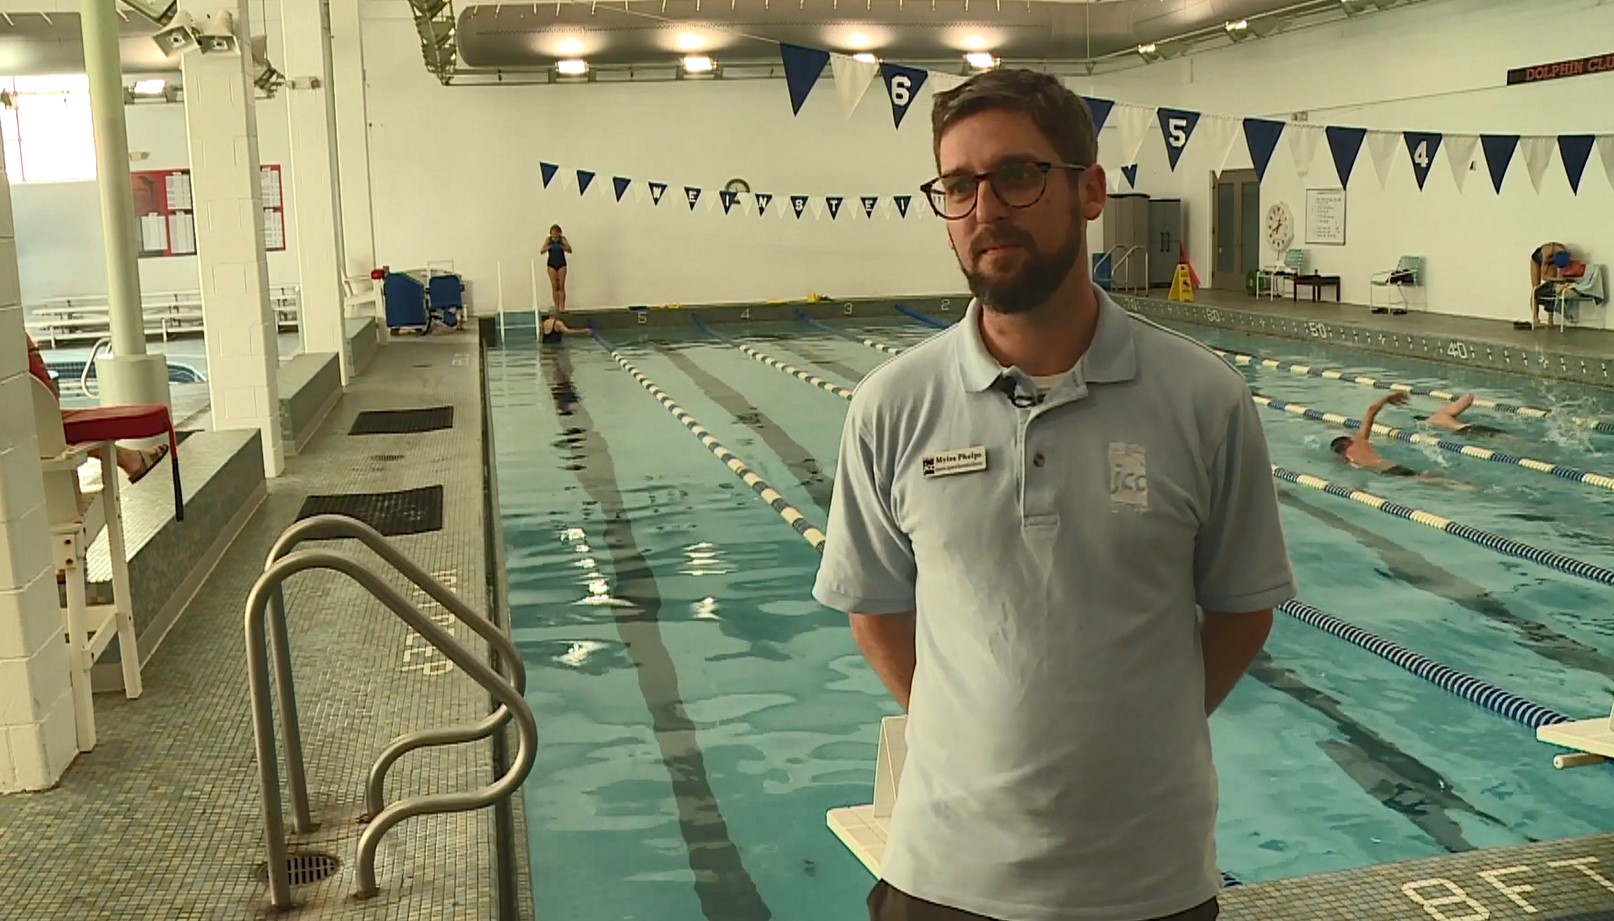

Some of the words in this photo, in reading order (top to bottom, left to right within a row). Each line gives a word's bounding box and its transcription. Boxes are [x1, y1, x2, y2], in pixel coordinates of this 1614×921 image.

[1526, 60, 1584, 81] DOLPHIN
[890, 75, 911, 106] 6
[1168, 118, 1187, 147] 5
[1413, 140, 1429, 168] 4
[843, 302, 853, 315] 3
[940, 298, 951, 311] 2
[740, 308, 750, 319] 4
[1309, 322, 1327, 339] 50
[1447, 341, 1468, 359] 40
[958, 451, 982, 461] Phelps
